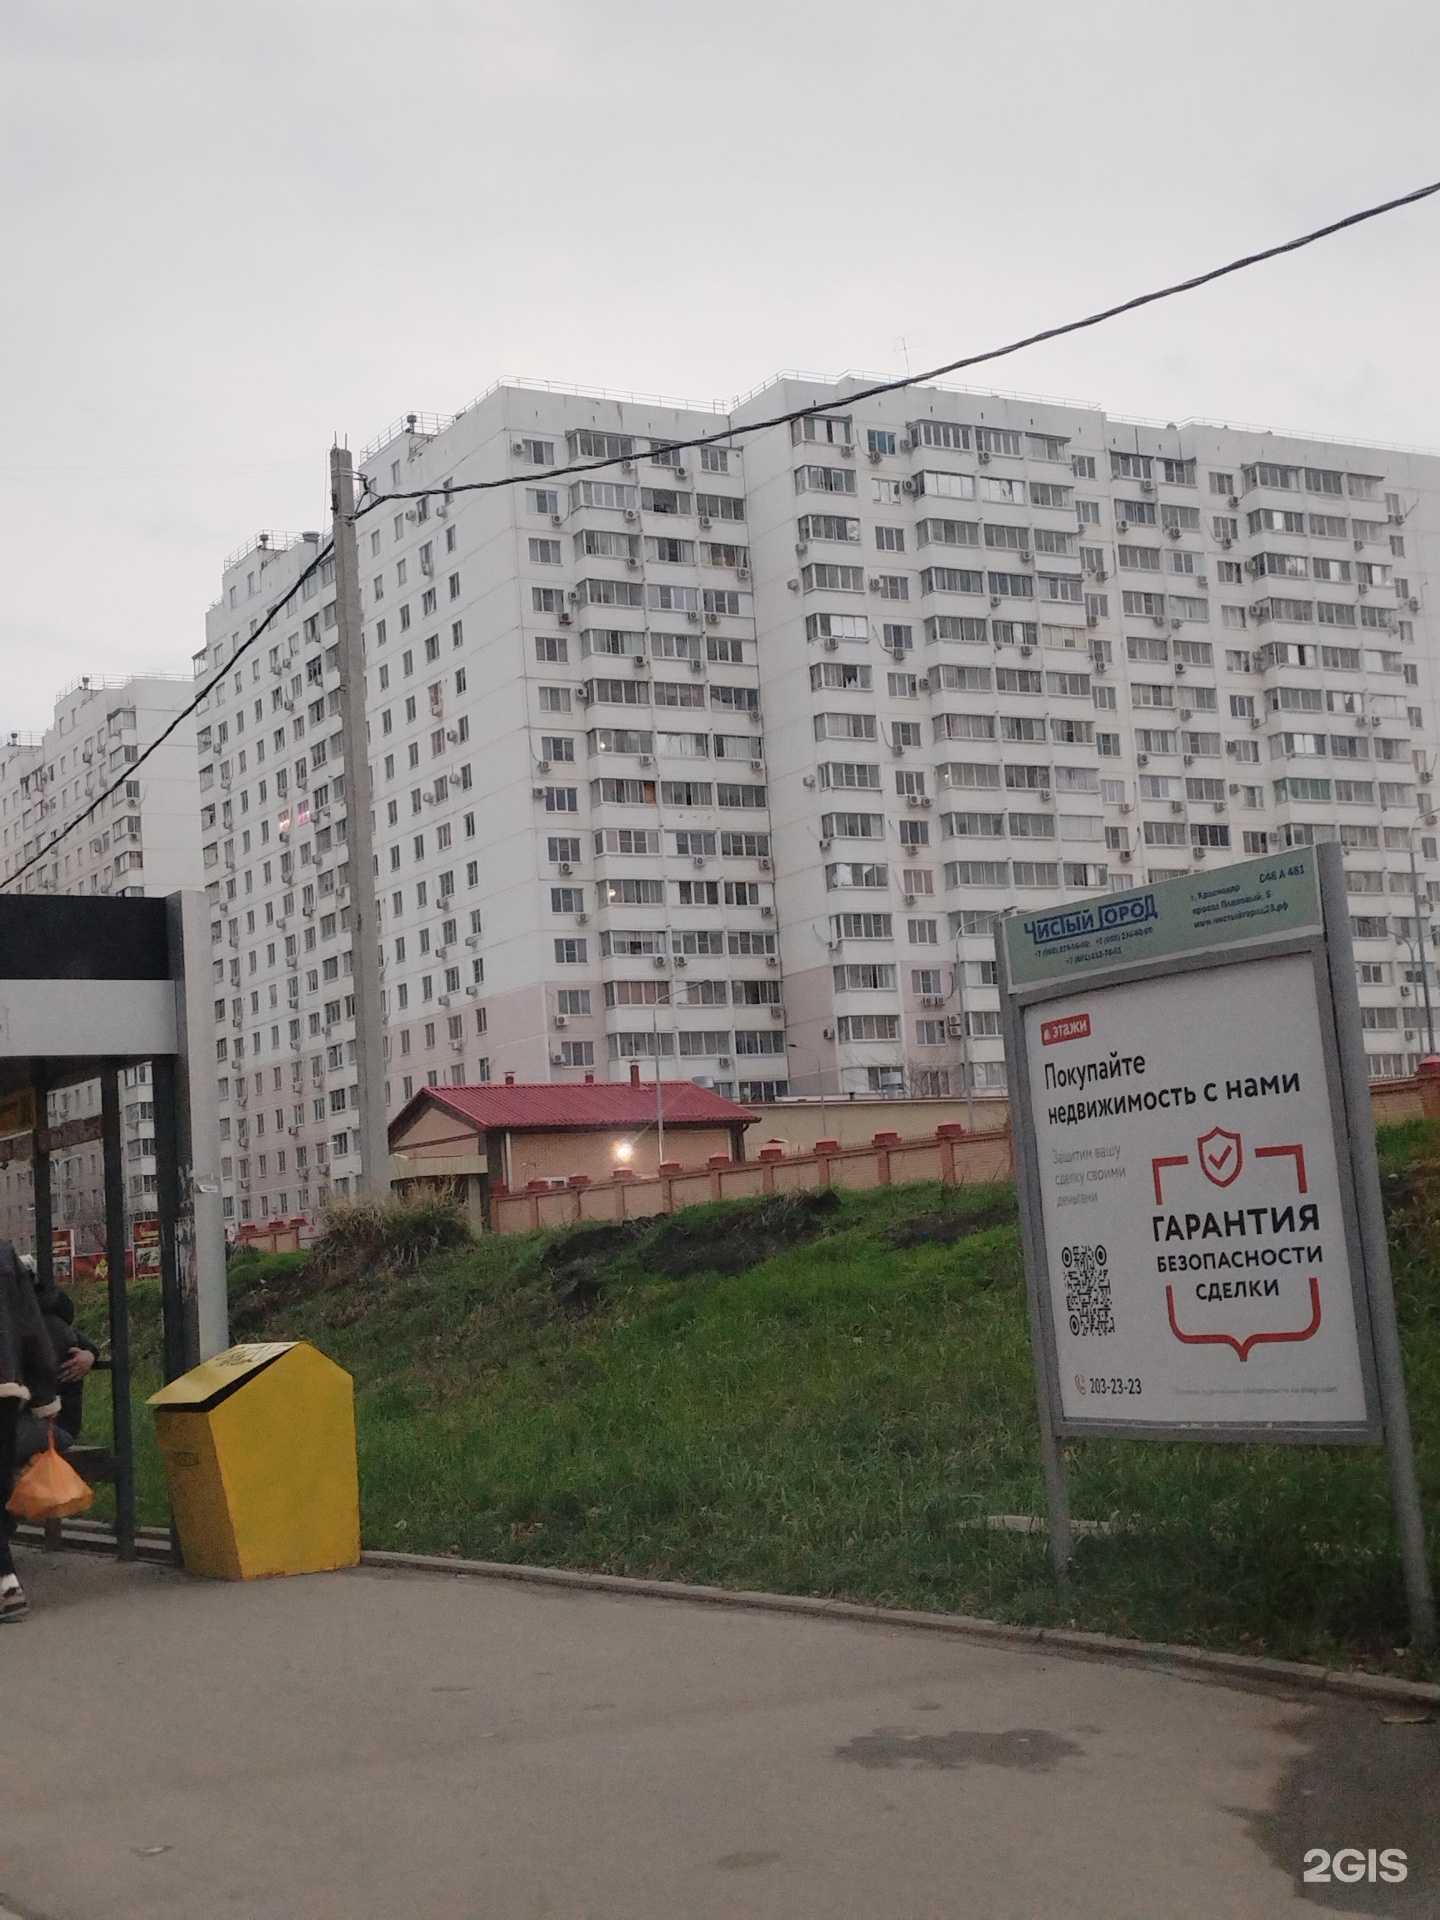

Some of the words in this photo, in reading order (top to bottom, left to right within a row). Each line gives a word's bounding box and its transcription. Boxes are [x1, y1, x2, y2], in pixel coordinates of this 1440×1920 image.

[1044, 1051, 1146, 1091] Покупайте
[1048, 1086, 1197, 1125] недвижимость
[1203, 1082, 1218, 1102] с
[1225, 1072, 1301, 1100] нами
[1152, 1204, 1320, 1242] ГАРАНТИЯ
[1157, 1245, 1323, 1273] БЕЗОПАСНОСТИ
[1196, 1279, 1279, 1302] СДЕЛКИ
[1089, 1377, 1142, 1395] 203-23-23
